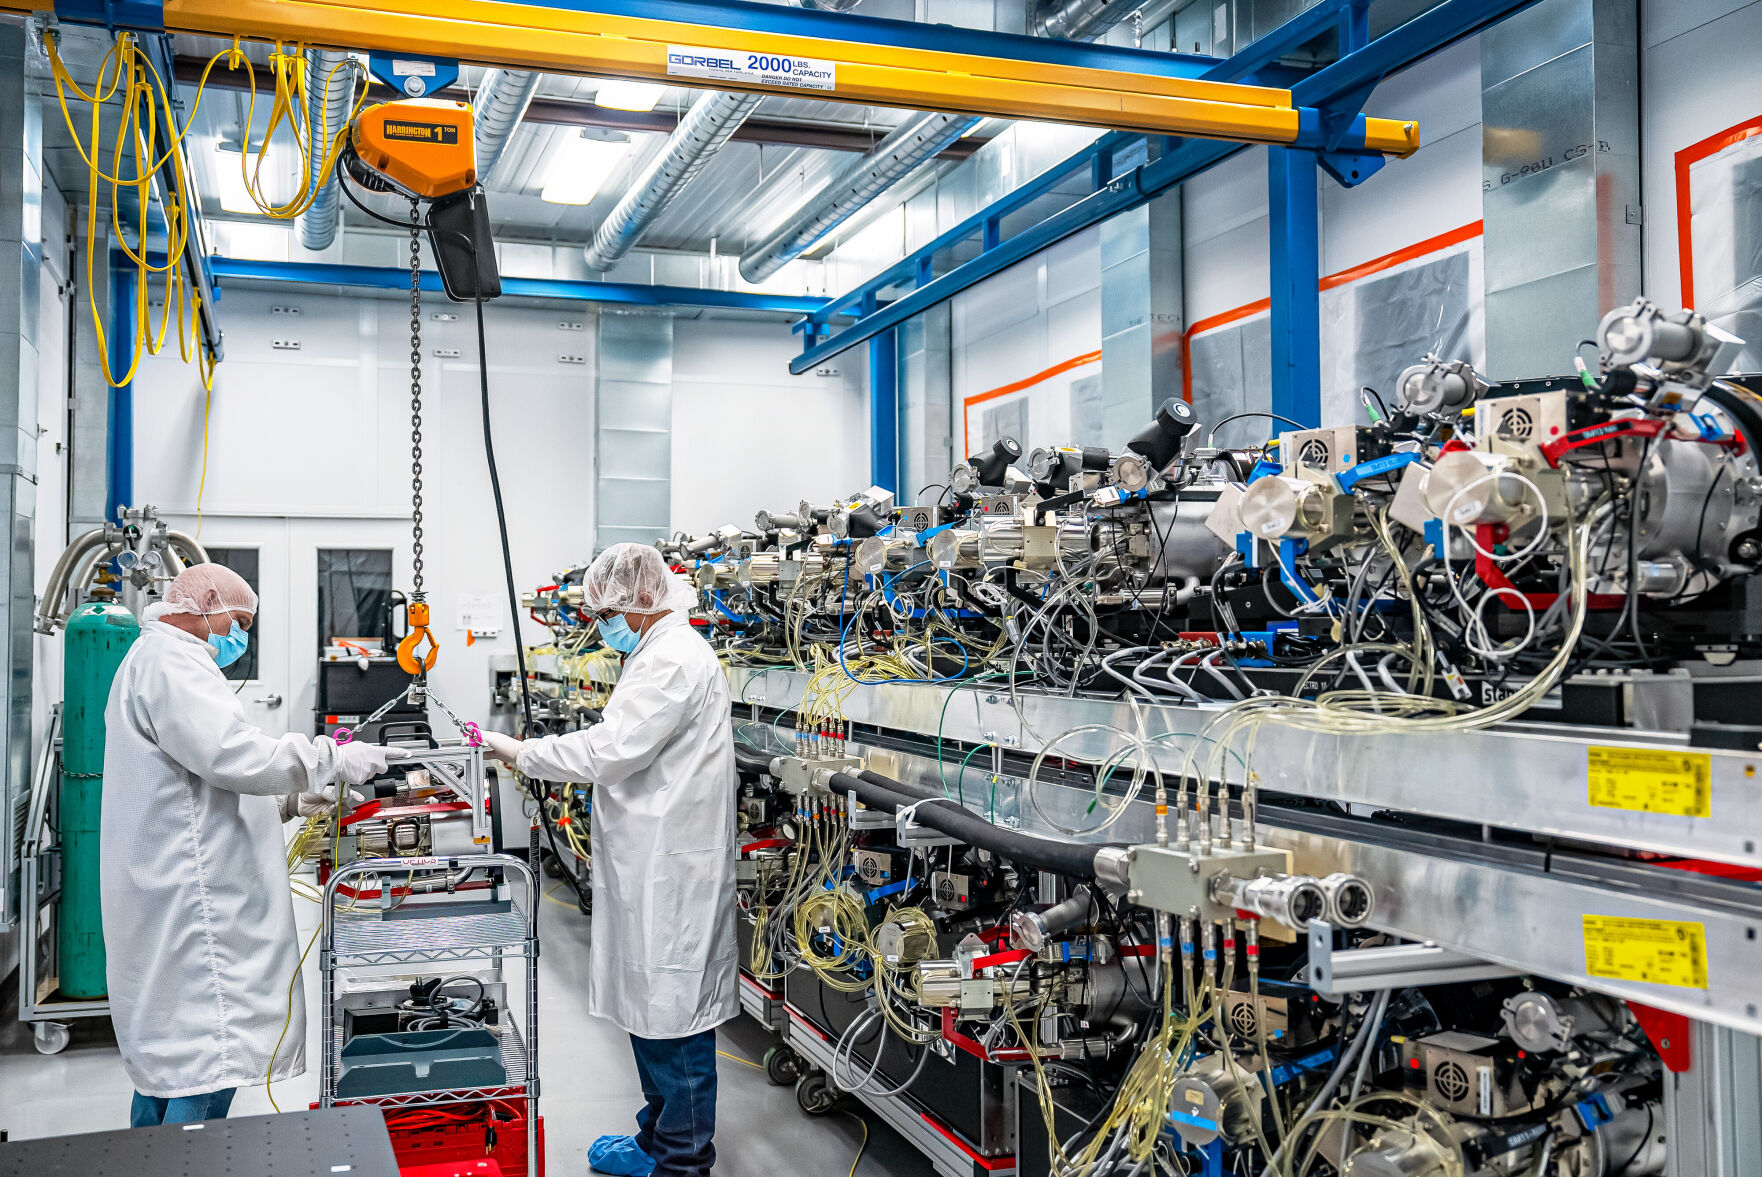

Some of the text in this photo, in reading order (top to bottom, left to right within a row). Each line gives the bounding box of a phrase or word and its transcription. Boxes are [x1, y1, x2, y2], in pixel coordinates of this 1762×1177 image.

[668, 53, 741, 71] GORBEL
[747, 55, 792, 73] 2000
[792, 60, 811, 69] LBS.
[792, 68, 832, 79] CAPACITY
[799, 82, 824, 90] CAPACITY
[386, 124, 431, 138] HARRINGTON
[433, 126, 443, 141] 1
